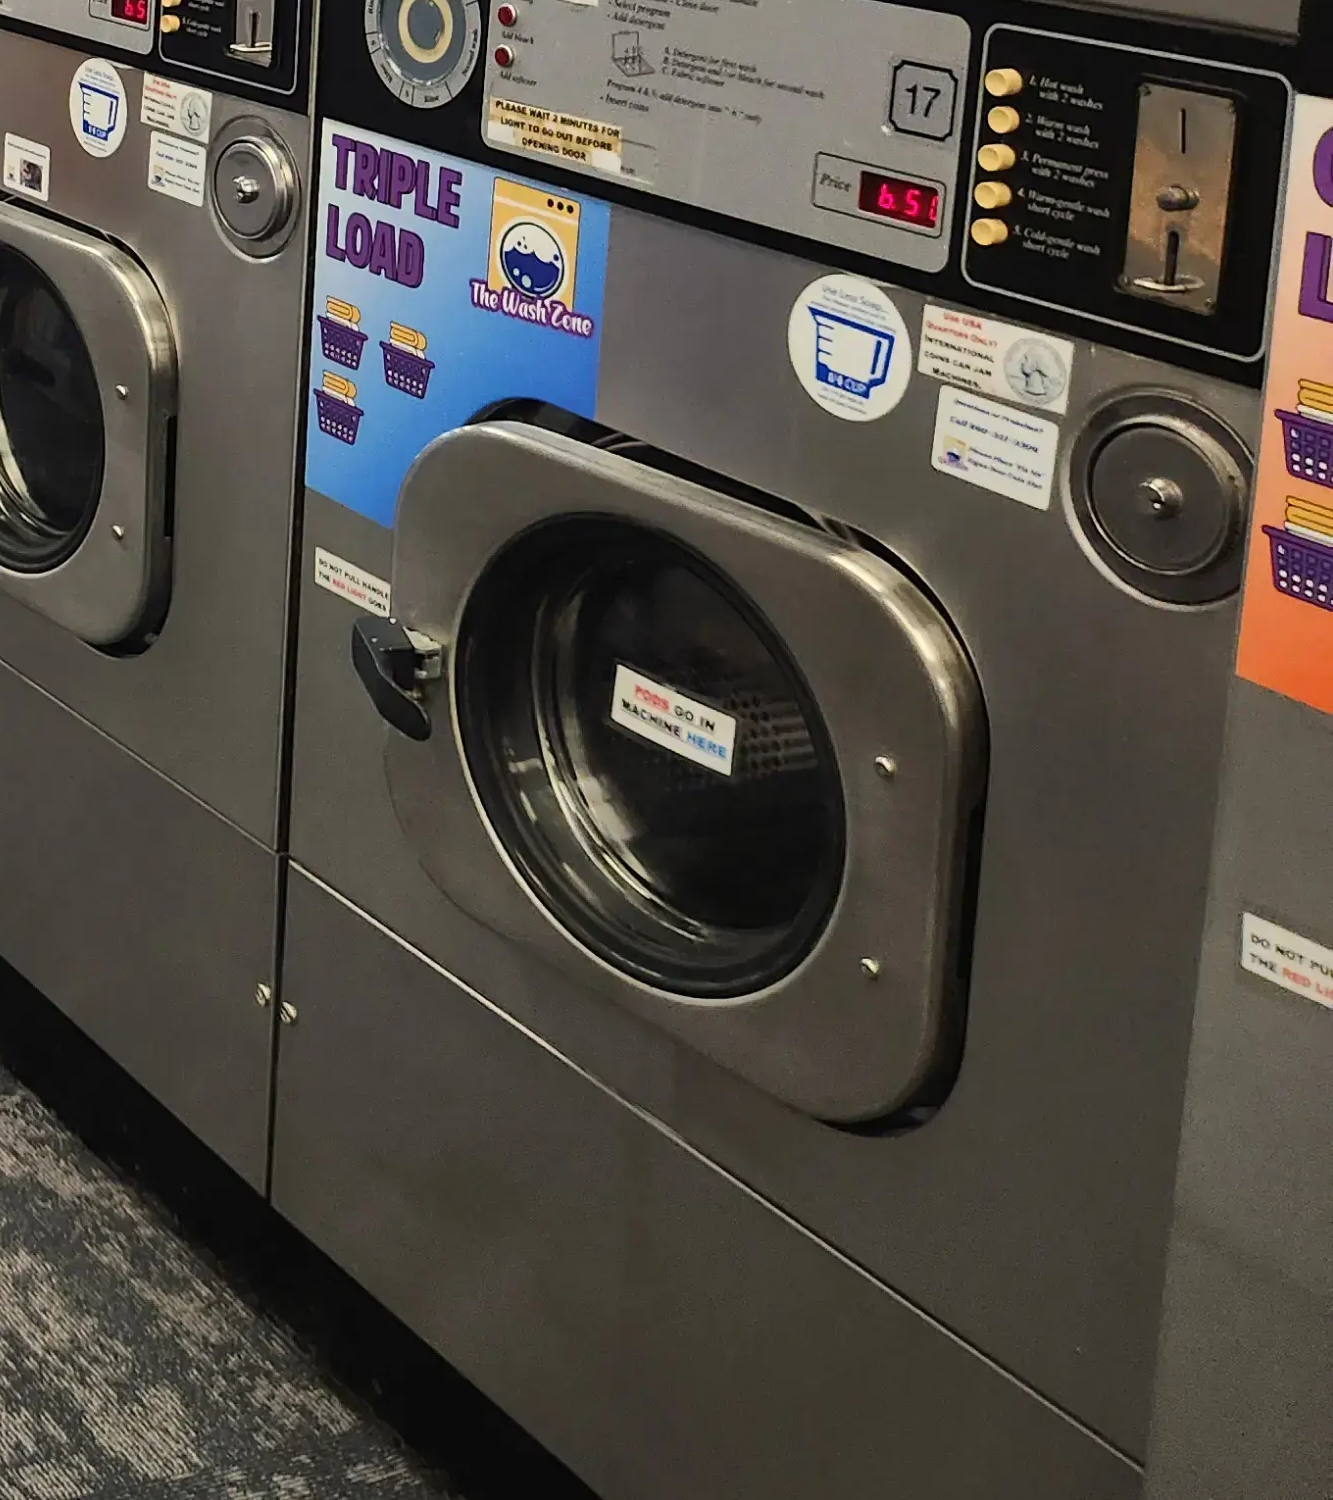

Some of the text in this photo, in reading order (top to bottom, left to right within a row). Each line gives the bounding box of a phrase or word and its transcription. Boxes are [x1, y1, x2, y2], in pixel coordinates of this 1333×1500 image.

[905, 84, 941, 118] 17
[1040, 76, 1058, 89] Hot
[1060, 83, 1084, 95] wash
[496, 100, 620, 138] PLEASE WAIT 2 MINUTES FOR
[500, 116, 613, 151] LIGHT TO GO OUT BEFORE
[522, 137, 586, 161] OPENING DOOR
[332, 133, 462, 229] TRIPLE
[819, 173, 852, 192] Price
[326, 203, 425, 288] LOAD
[470, 280, 593, 336] The Wash Zone
[962, 316, 982, 330] USA
[844, 377, 867, 393] CUP
[319, 558, 388, 599] DO NOT PULL HANDLE
[319, 571, 330, 582] THE
[332, 578, 345, 589] RED
[634, 683, 716, 732] PODS GO IN
[621, 697, 728, 759] MACHINE HERE
[1251, 933, 1305, 964] DO NOT
[1249, 952, 1311, 988] THE RED
